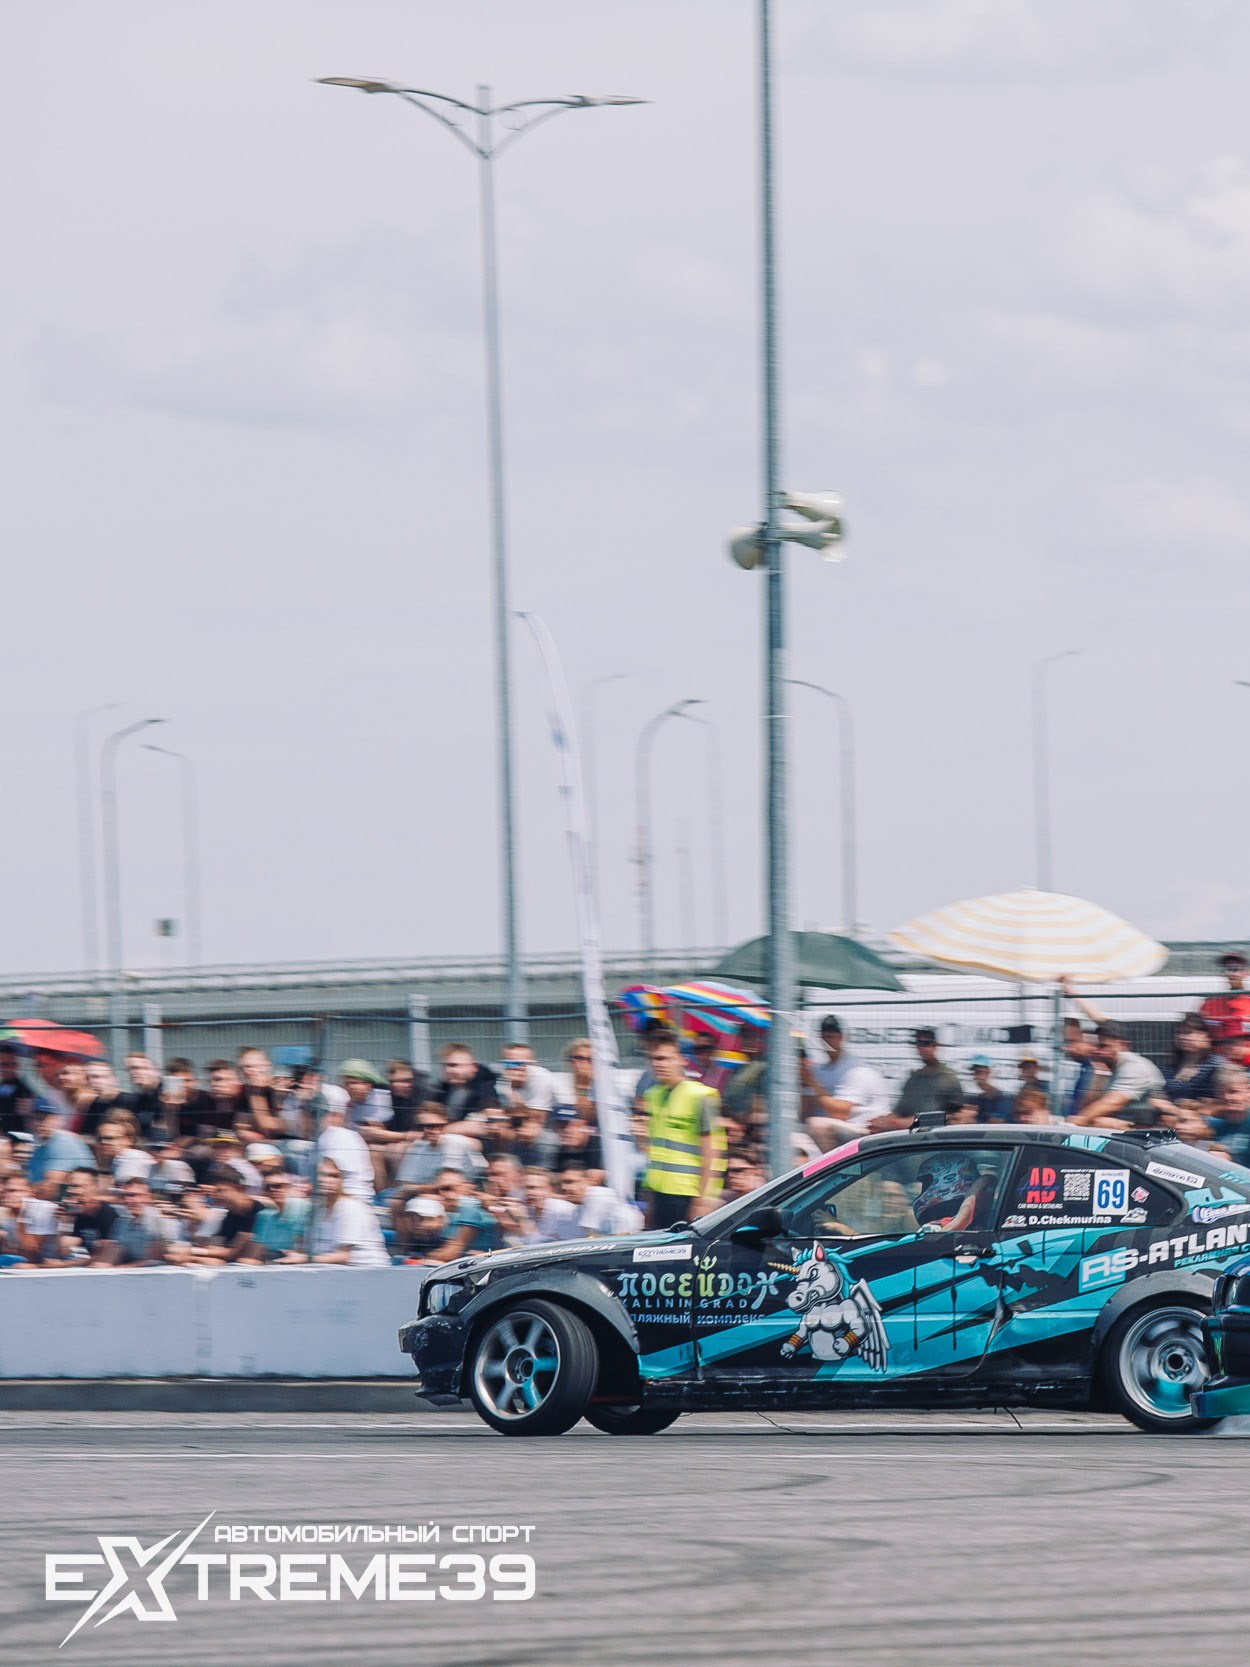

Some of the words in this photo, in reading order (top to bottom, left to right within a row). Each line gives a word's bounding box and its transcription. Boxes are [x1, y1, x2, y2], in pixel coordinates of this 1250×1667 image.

[1097, 1179, 1126, 1209] 69
[1028, 1214, 1112, 1225] D.Chekmurina
[617, 1256, 780, 1310] ПОСЕЙДОН
